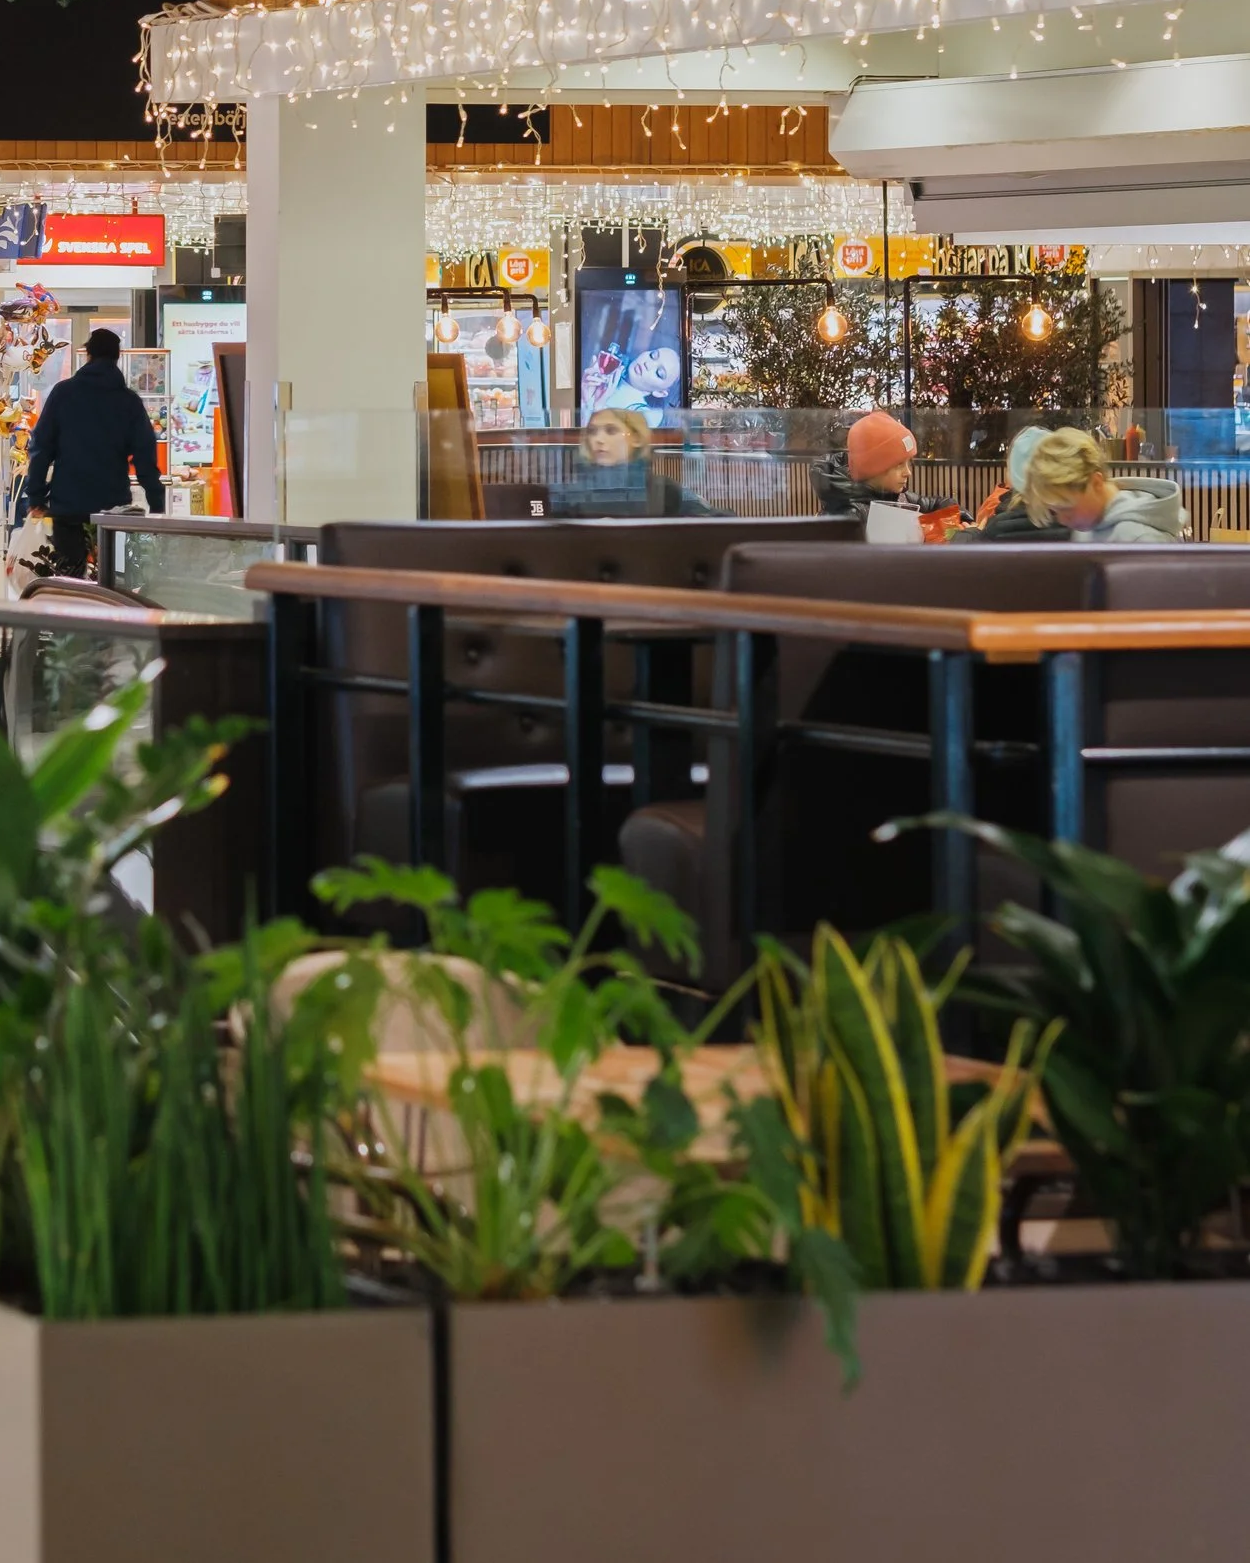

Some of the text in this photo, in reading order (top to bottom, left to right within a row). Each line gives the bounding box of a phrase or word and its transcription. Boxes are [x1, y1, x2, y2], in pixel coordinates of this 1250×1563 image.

[57, 241, 152, 254] SVENSKA SPEL
[689, 258, 712, 273] ICA
